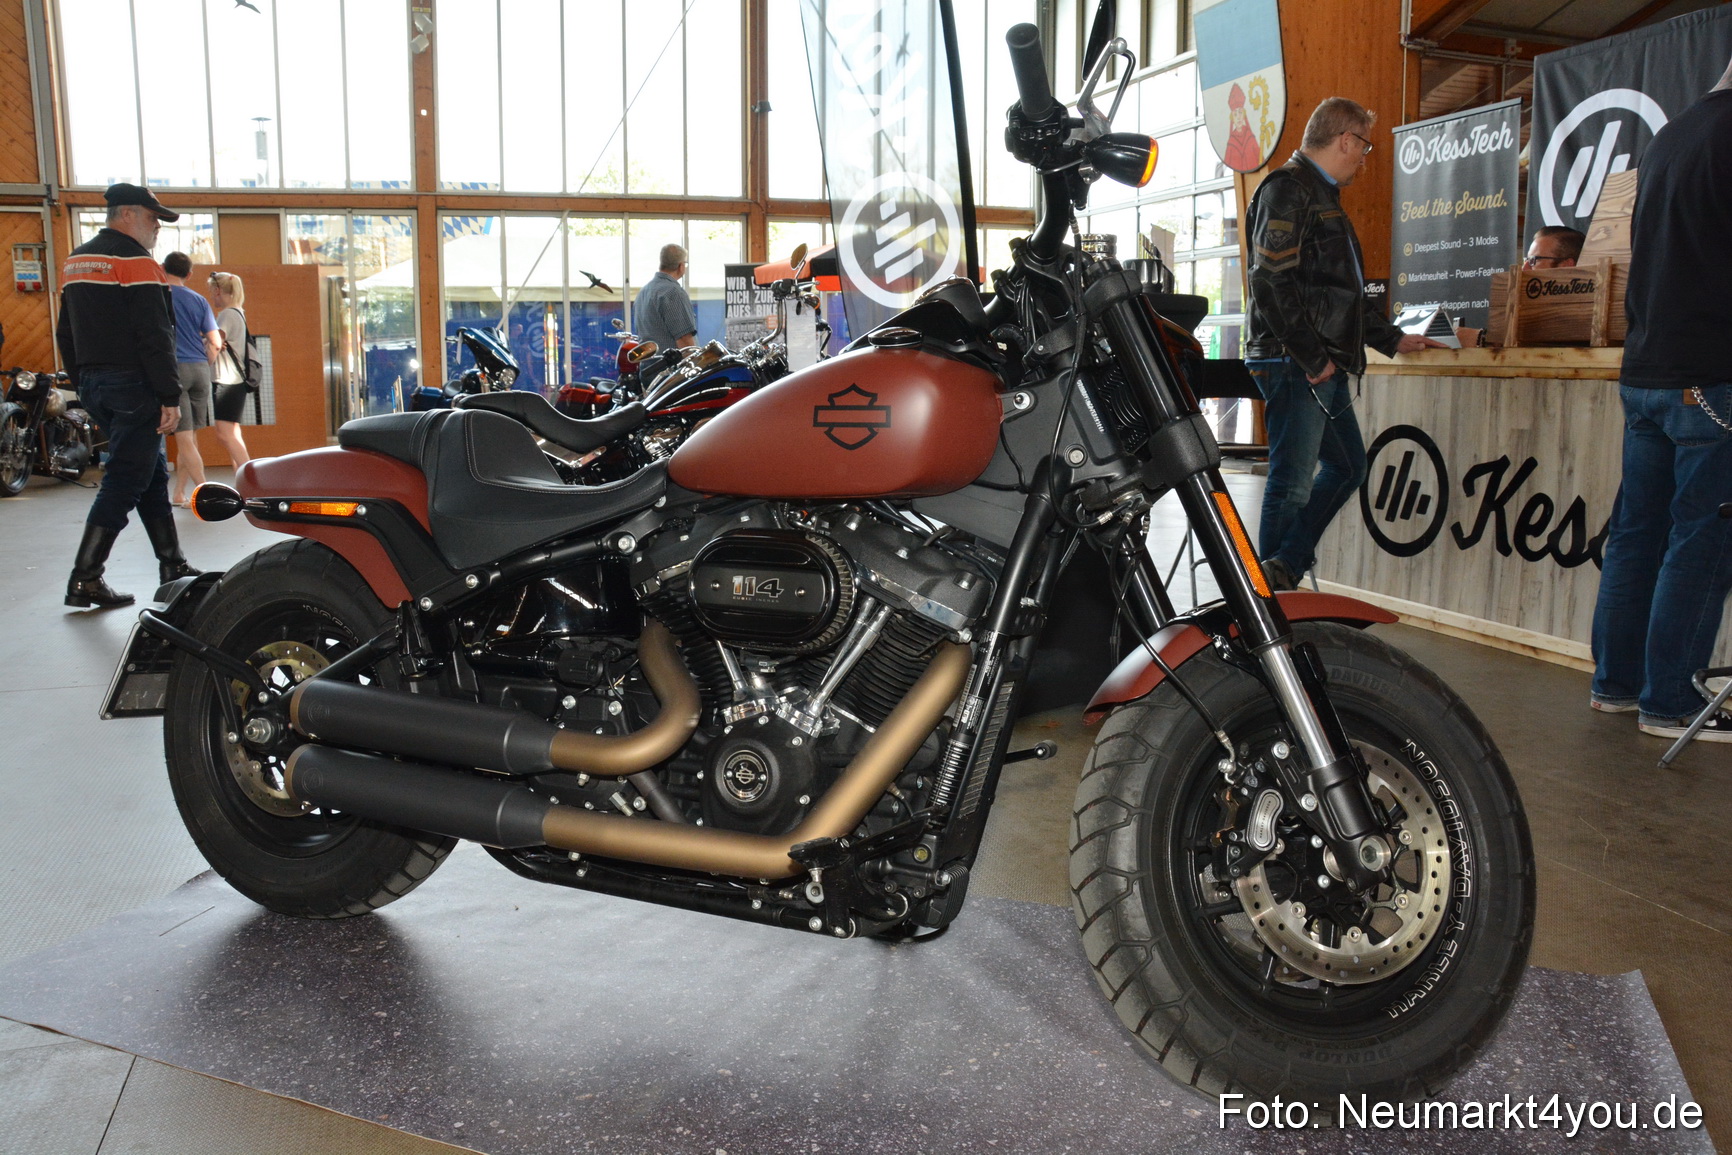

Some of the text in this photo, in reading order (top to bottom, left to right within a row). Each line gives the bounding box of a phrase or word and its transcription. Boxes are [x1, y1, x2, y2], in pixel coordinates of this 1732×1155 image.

[1425, 121, 1514, 165] KessTech
[1400, 188, 1508, 222] Feel the Sound.
[1414, 241, 1440, 253] Deepest
[1440, 239, 1462, 250] Sound
[1468, 237, 1475, 247] 3
[1475, 235, 1499, 246] Modes
[726, 276, 747, 290] WIR
[1408, 270, 1449, 283] Marktneuheit
[1542, 278, 1595, 296] KessTech
[726, 290, 750, 305] DICH
[1471, 298, 1490, 308] nach
[726, 305, 751, 318] AUFS
[732, 576, 784, 598] 114
